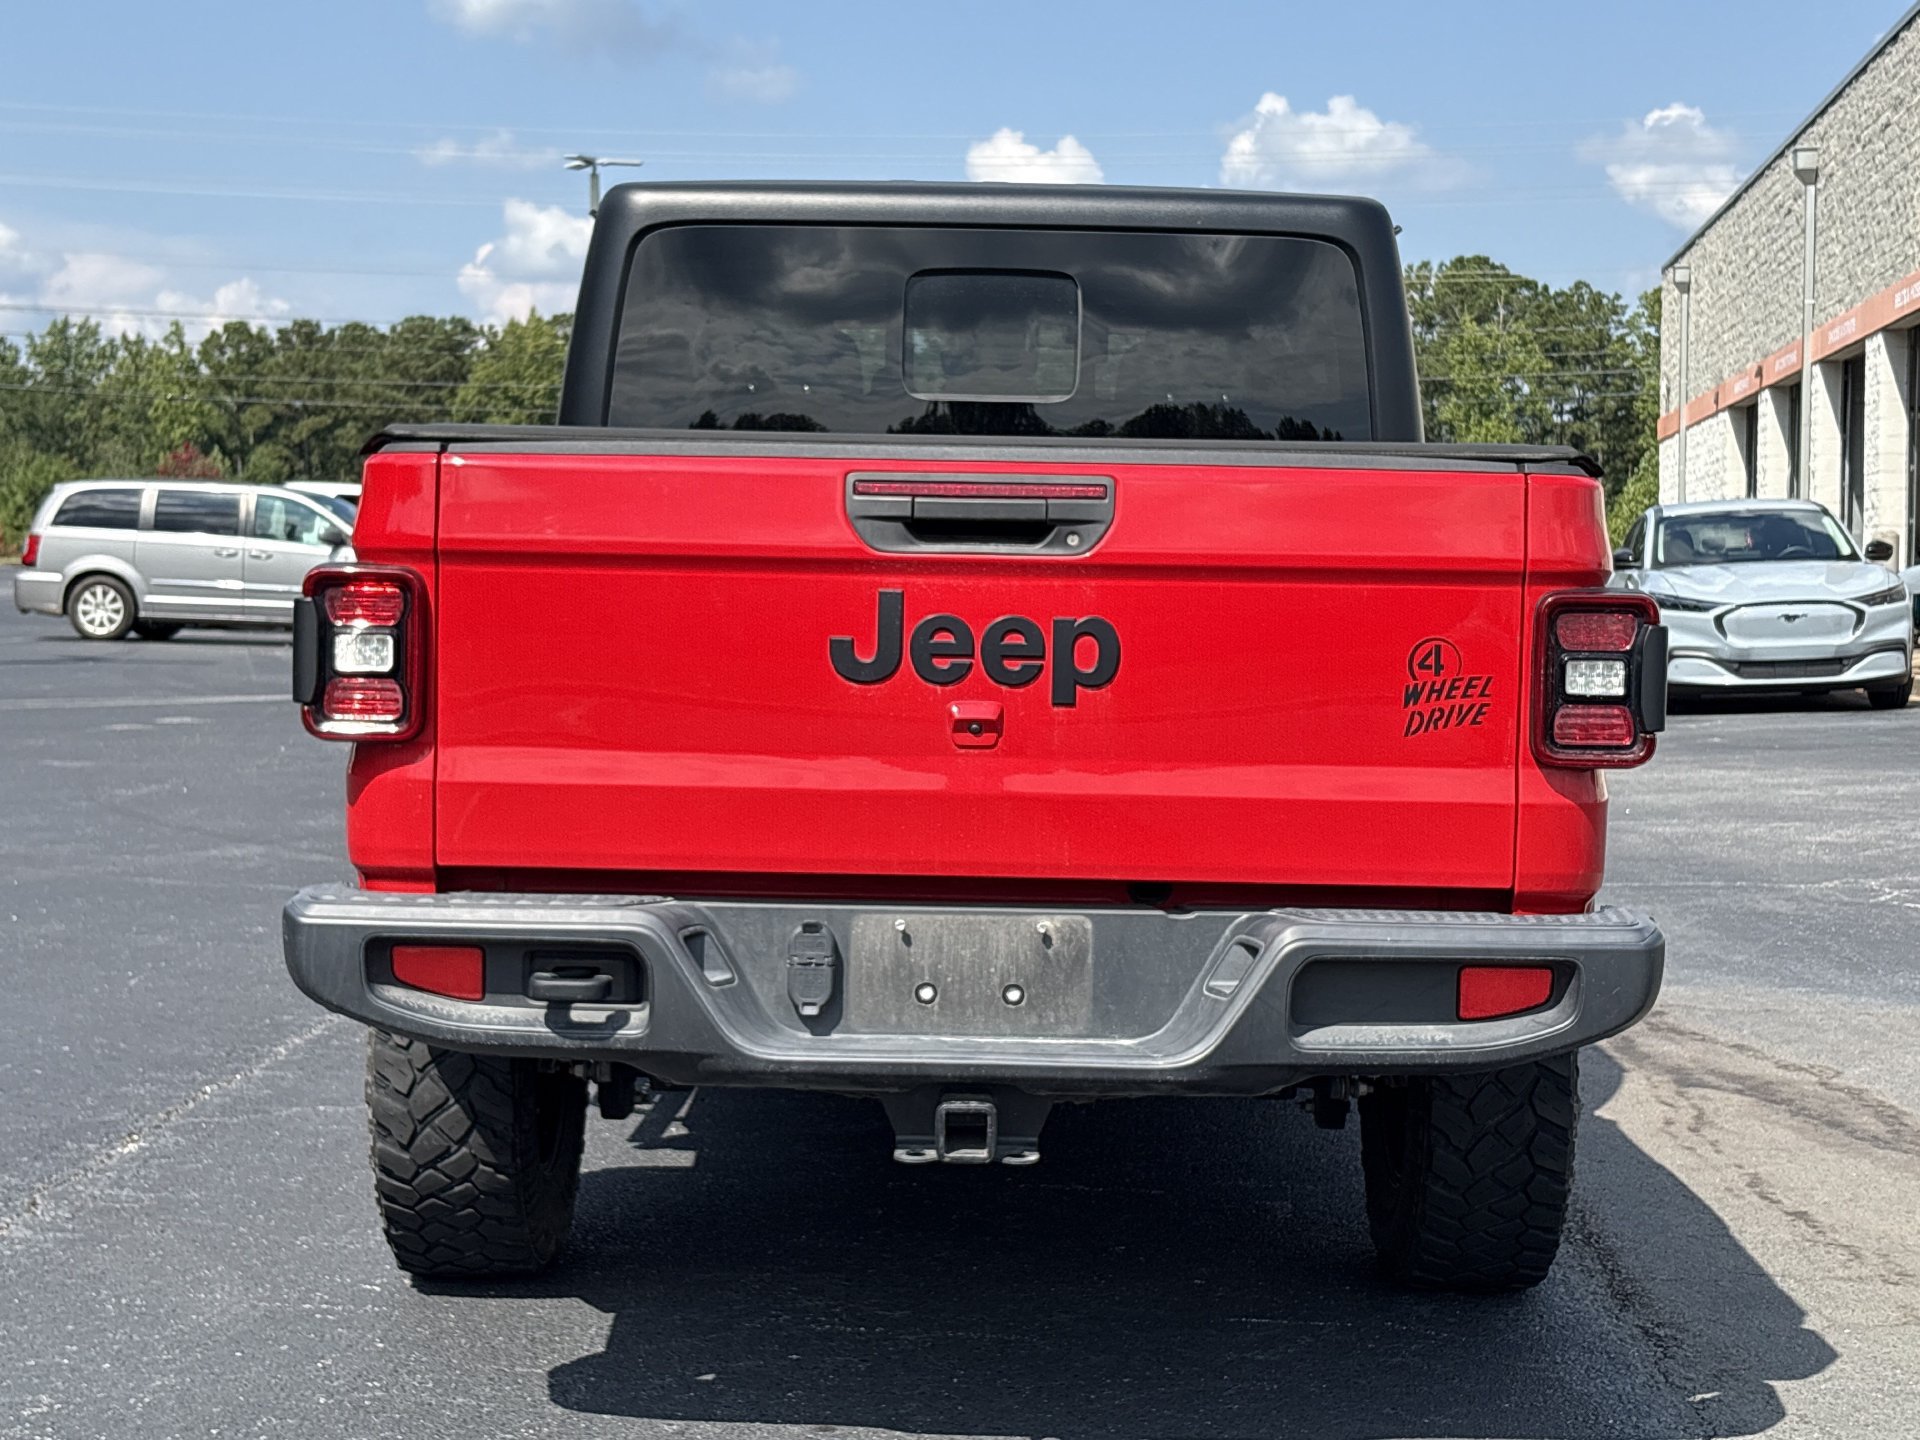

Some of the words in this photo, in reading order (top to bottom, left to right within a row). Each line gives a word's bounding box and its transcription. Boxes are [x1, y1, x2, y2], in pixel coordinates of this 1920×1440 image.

[829, 588, 1122, 707] Jeep
[1417, 644, 1445, 677] 4
[1403, 676, 1493, 709] WHEEL
[1403, 703, 1492, 738] DRIVE
